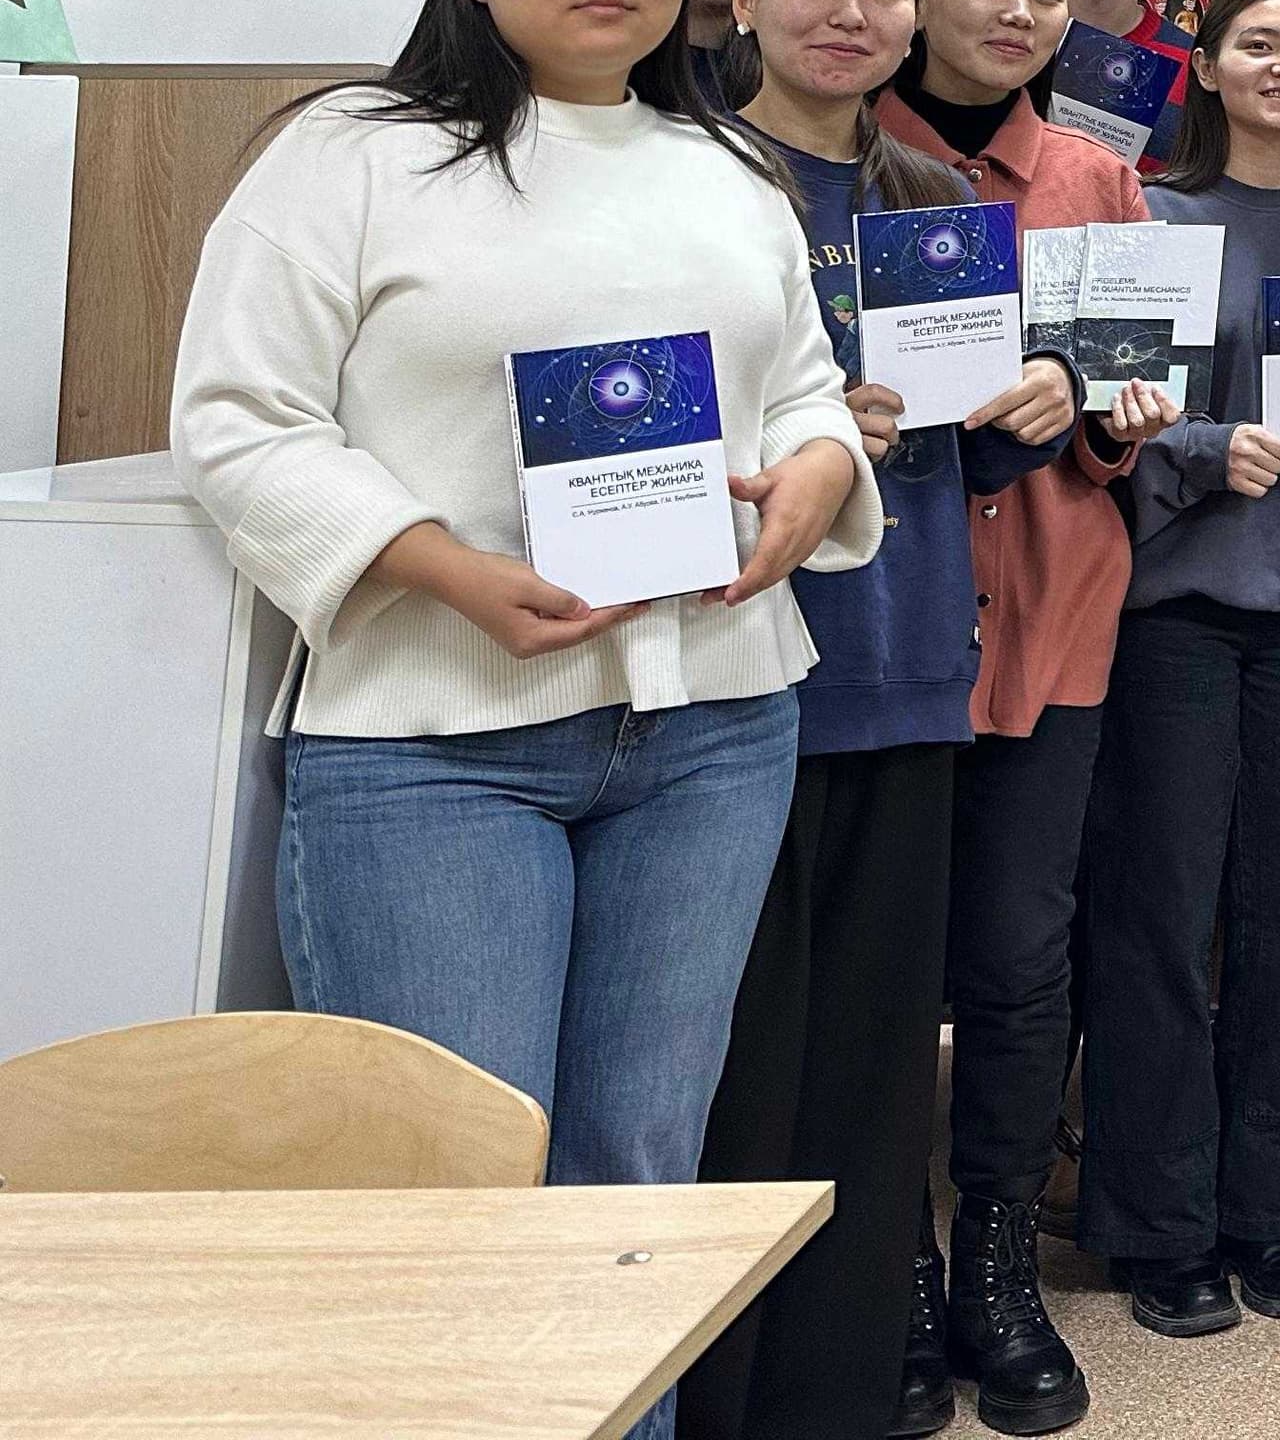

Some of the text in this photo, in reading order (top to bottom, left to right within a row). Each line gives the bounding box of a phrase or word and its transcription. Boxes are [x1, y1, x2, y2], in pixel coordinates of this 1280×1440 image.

[1101, 285, 1142, 294] QUANTUM
[1143, 286, 1191, 294] MECHANICS
[897, 308, 1003, 328] КВАНТТЫҚ МЕХАНИКА
[913, 324, 958, 337] ЕСЕПТЕР
[568, 459, 704, 489] КВАНТТЫҚ МЕХАНИКА
[590, 471, 704, 498] ЕСЕПТЕР ЖИНАҒЫ
